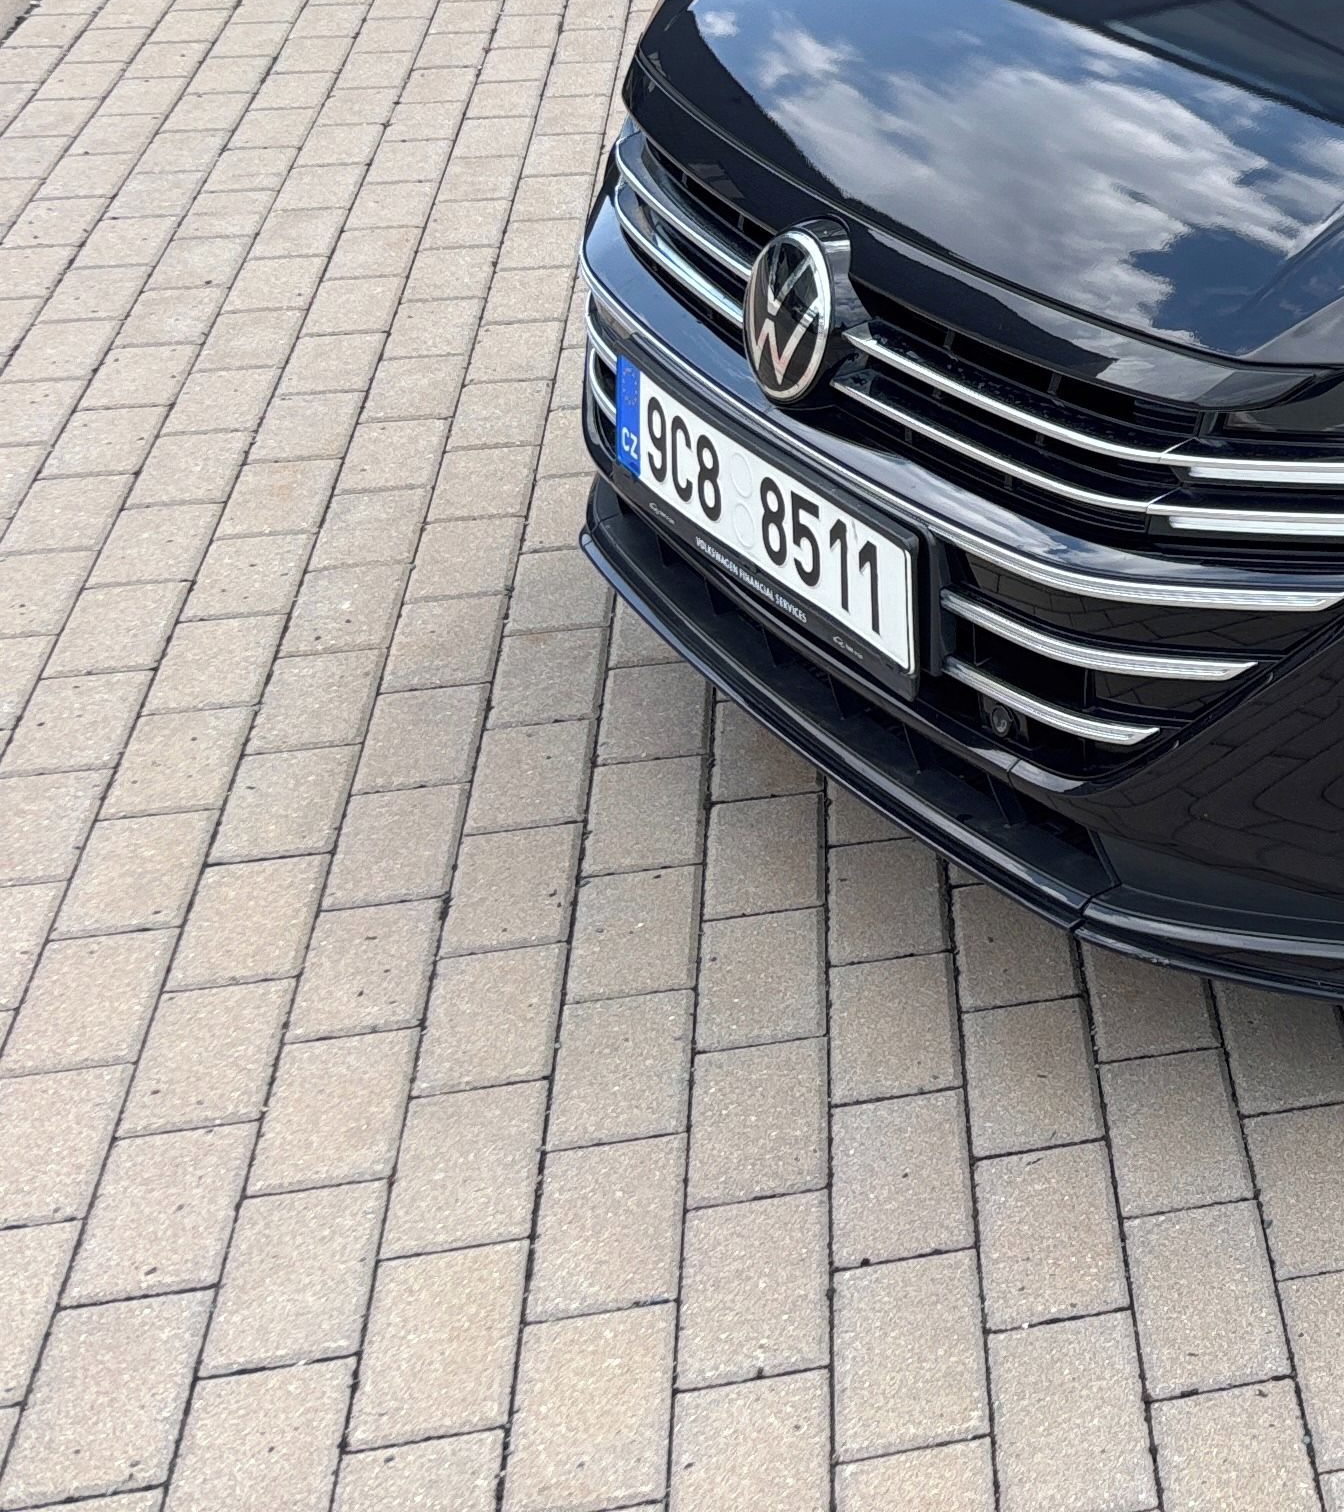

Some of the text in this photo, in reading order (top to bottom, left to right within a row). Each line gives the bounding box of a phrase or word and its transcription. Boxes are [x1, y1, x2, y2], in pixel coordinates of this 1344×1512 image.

[620, 426, 639, 461] CZ
[646, 395, 883, 637] 9C8 8511
[695, 535, 808, 624] VOLKSWAGEN FINANCIAL SERVICES
